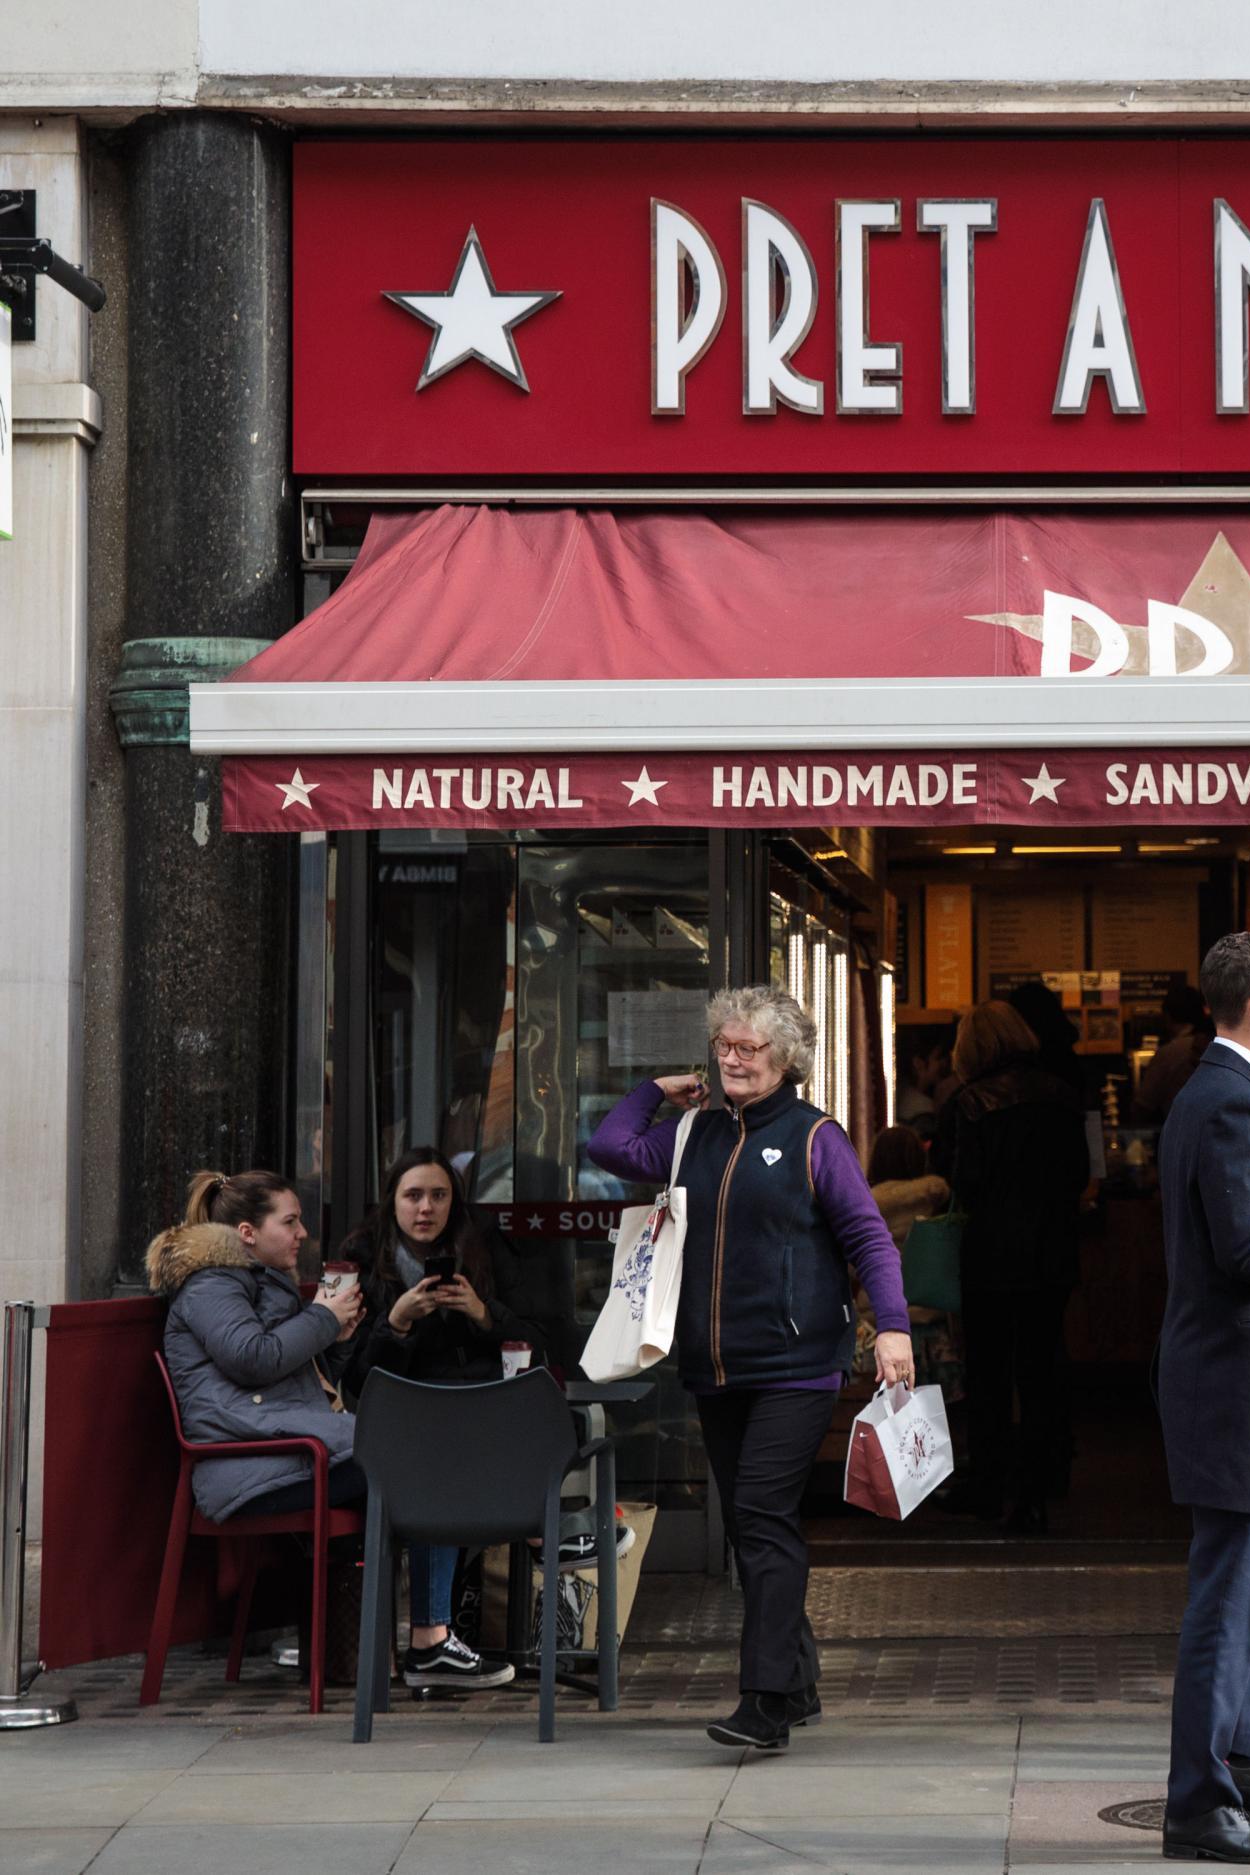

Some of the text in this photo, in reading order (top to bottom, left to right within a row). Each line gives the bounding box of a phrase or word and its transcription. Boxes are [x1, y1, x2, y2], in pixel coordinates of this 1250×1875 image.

[650, 195, 999, 416] PRET
[1052, 197, 1147, 415] A
[372, 767, 583, 811] NATURAL
[712, 763, 978, 808] HANDMADE
[559, 1211, 622, 1230] SOU
